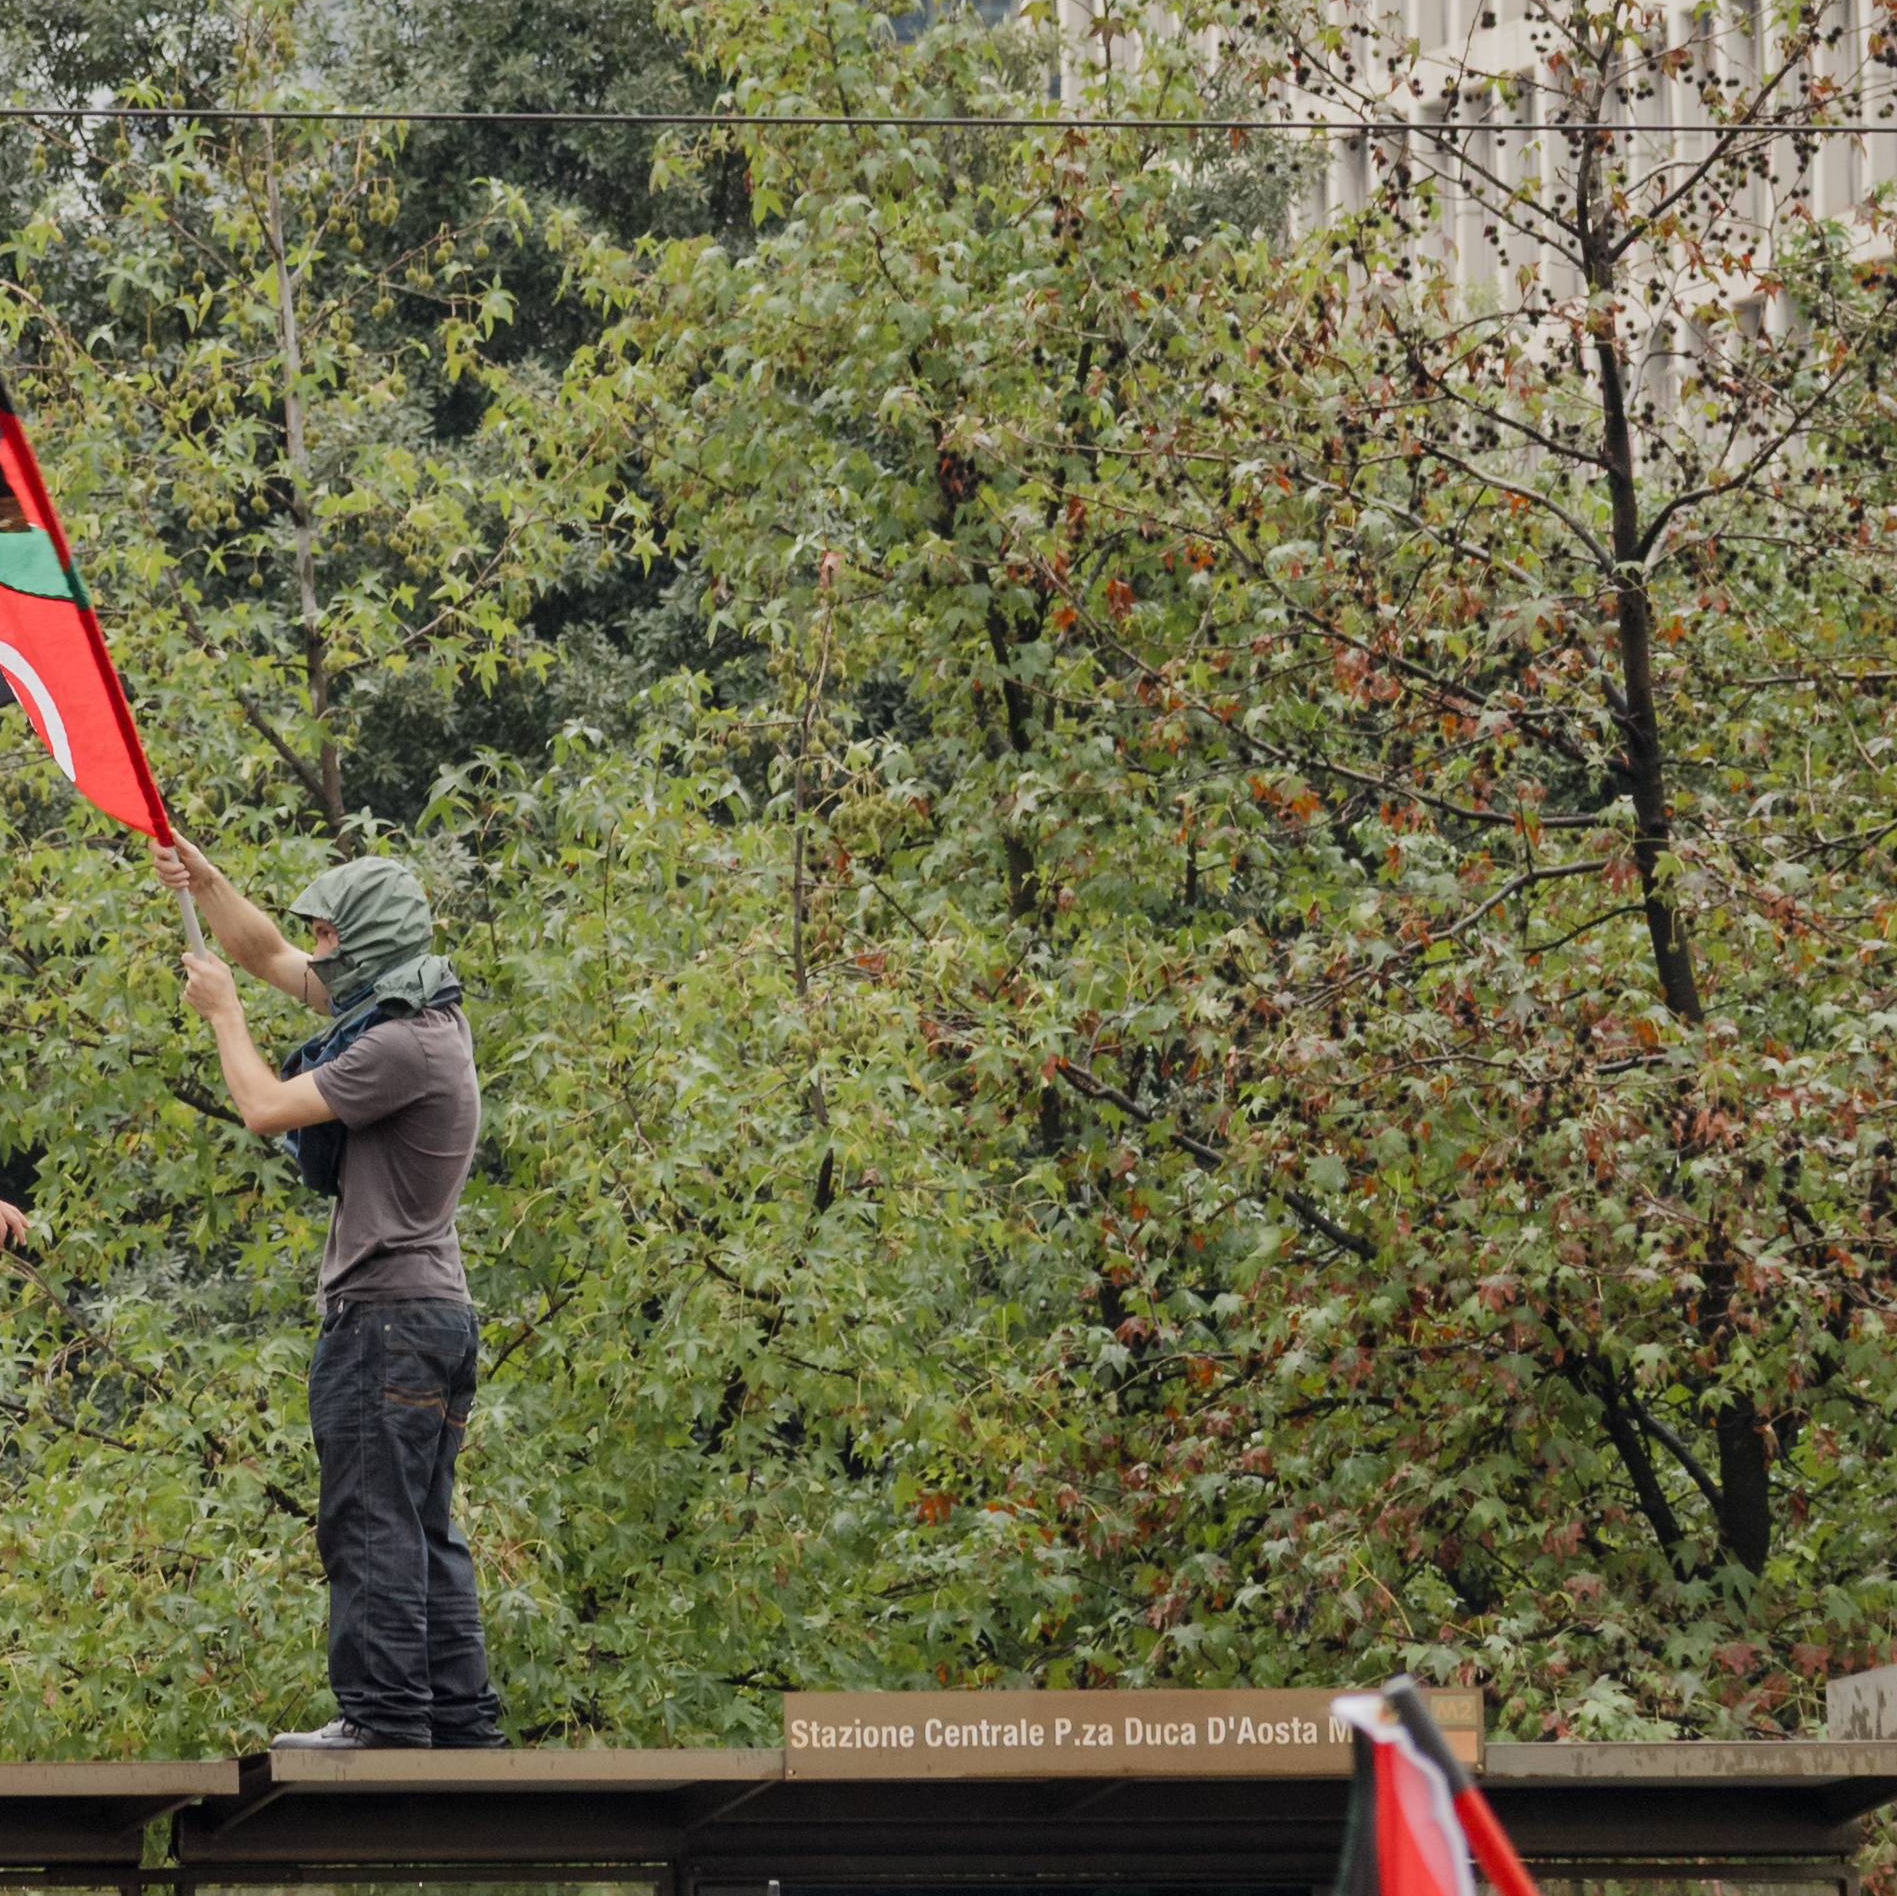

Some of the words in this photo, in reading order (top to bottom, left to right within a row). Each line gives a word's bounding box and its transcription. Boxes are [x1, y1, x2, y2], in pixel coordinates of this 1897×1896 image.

[1436, 1701, 1472, 1719] M2
[791, 1719, 914, 1748] Stazione
[924, 1718, 1044, 1747] Centrale
[1055, 1717, 1114, 1747] P.za
[1124, 1716, 1197, 1746] Duca
[1207, 1715, 1318, 1745] D'Aosta
